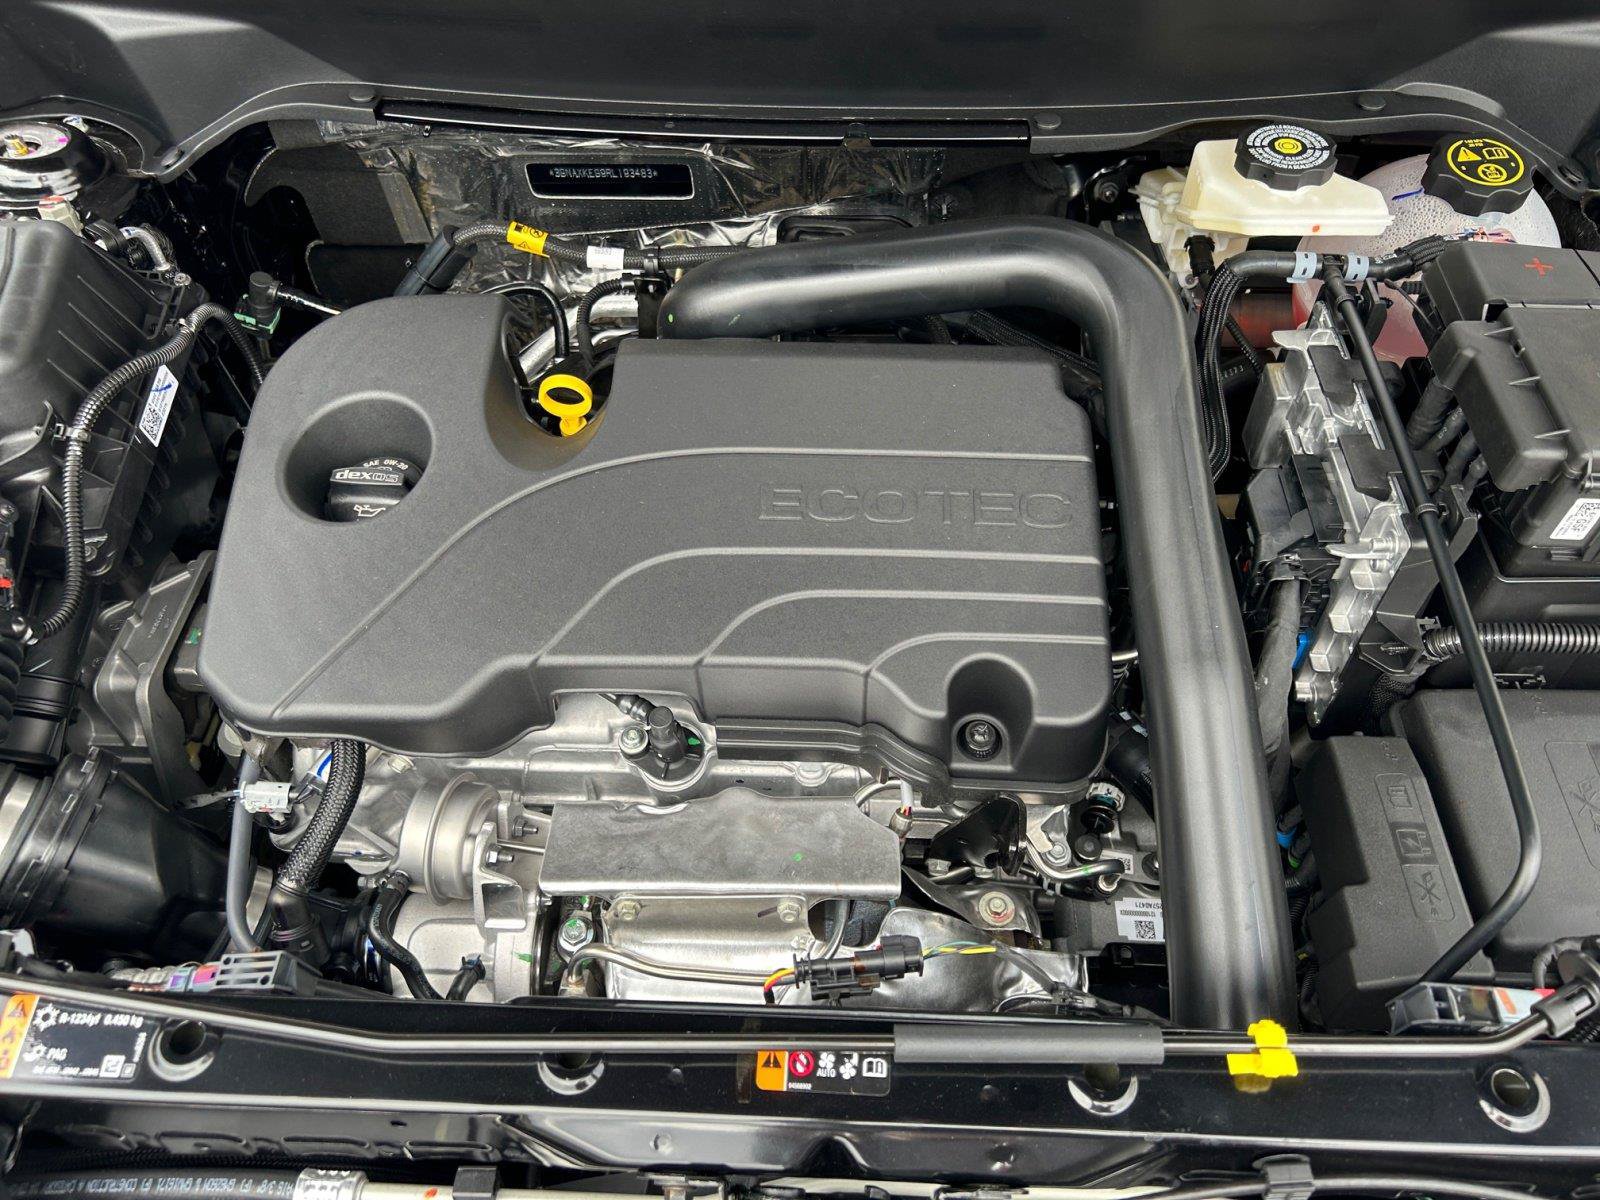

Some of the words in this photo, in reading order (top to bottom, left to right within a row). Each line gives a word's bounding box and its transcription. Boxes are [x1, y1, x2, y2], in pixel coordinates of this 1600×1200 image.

[335, 469, 400, 483] dexos
[758, 485, 1073, 529] ECOTEC
[130, 1014, 144, 1029] kg
[816, 1068, 836, 1077] AUTO
